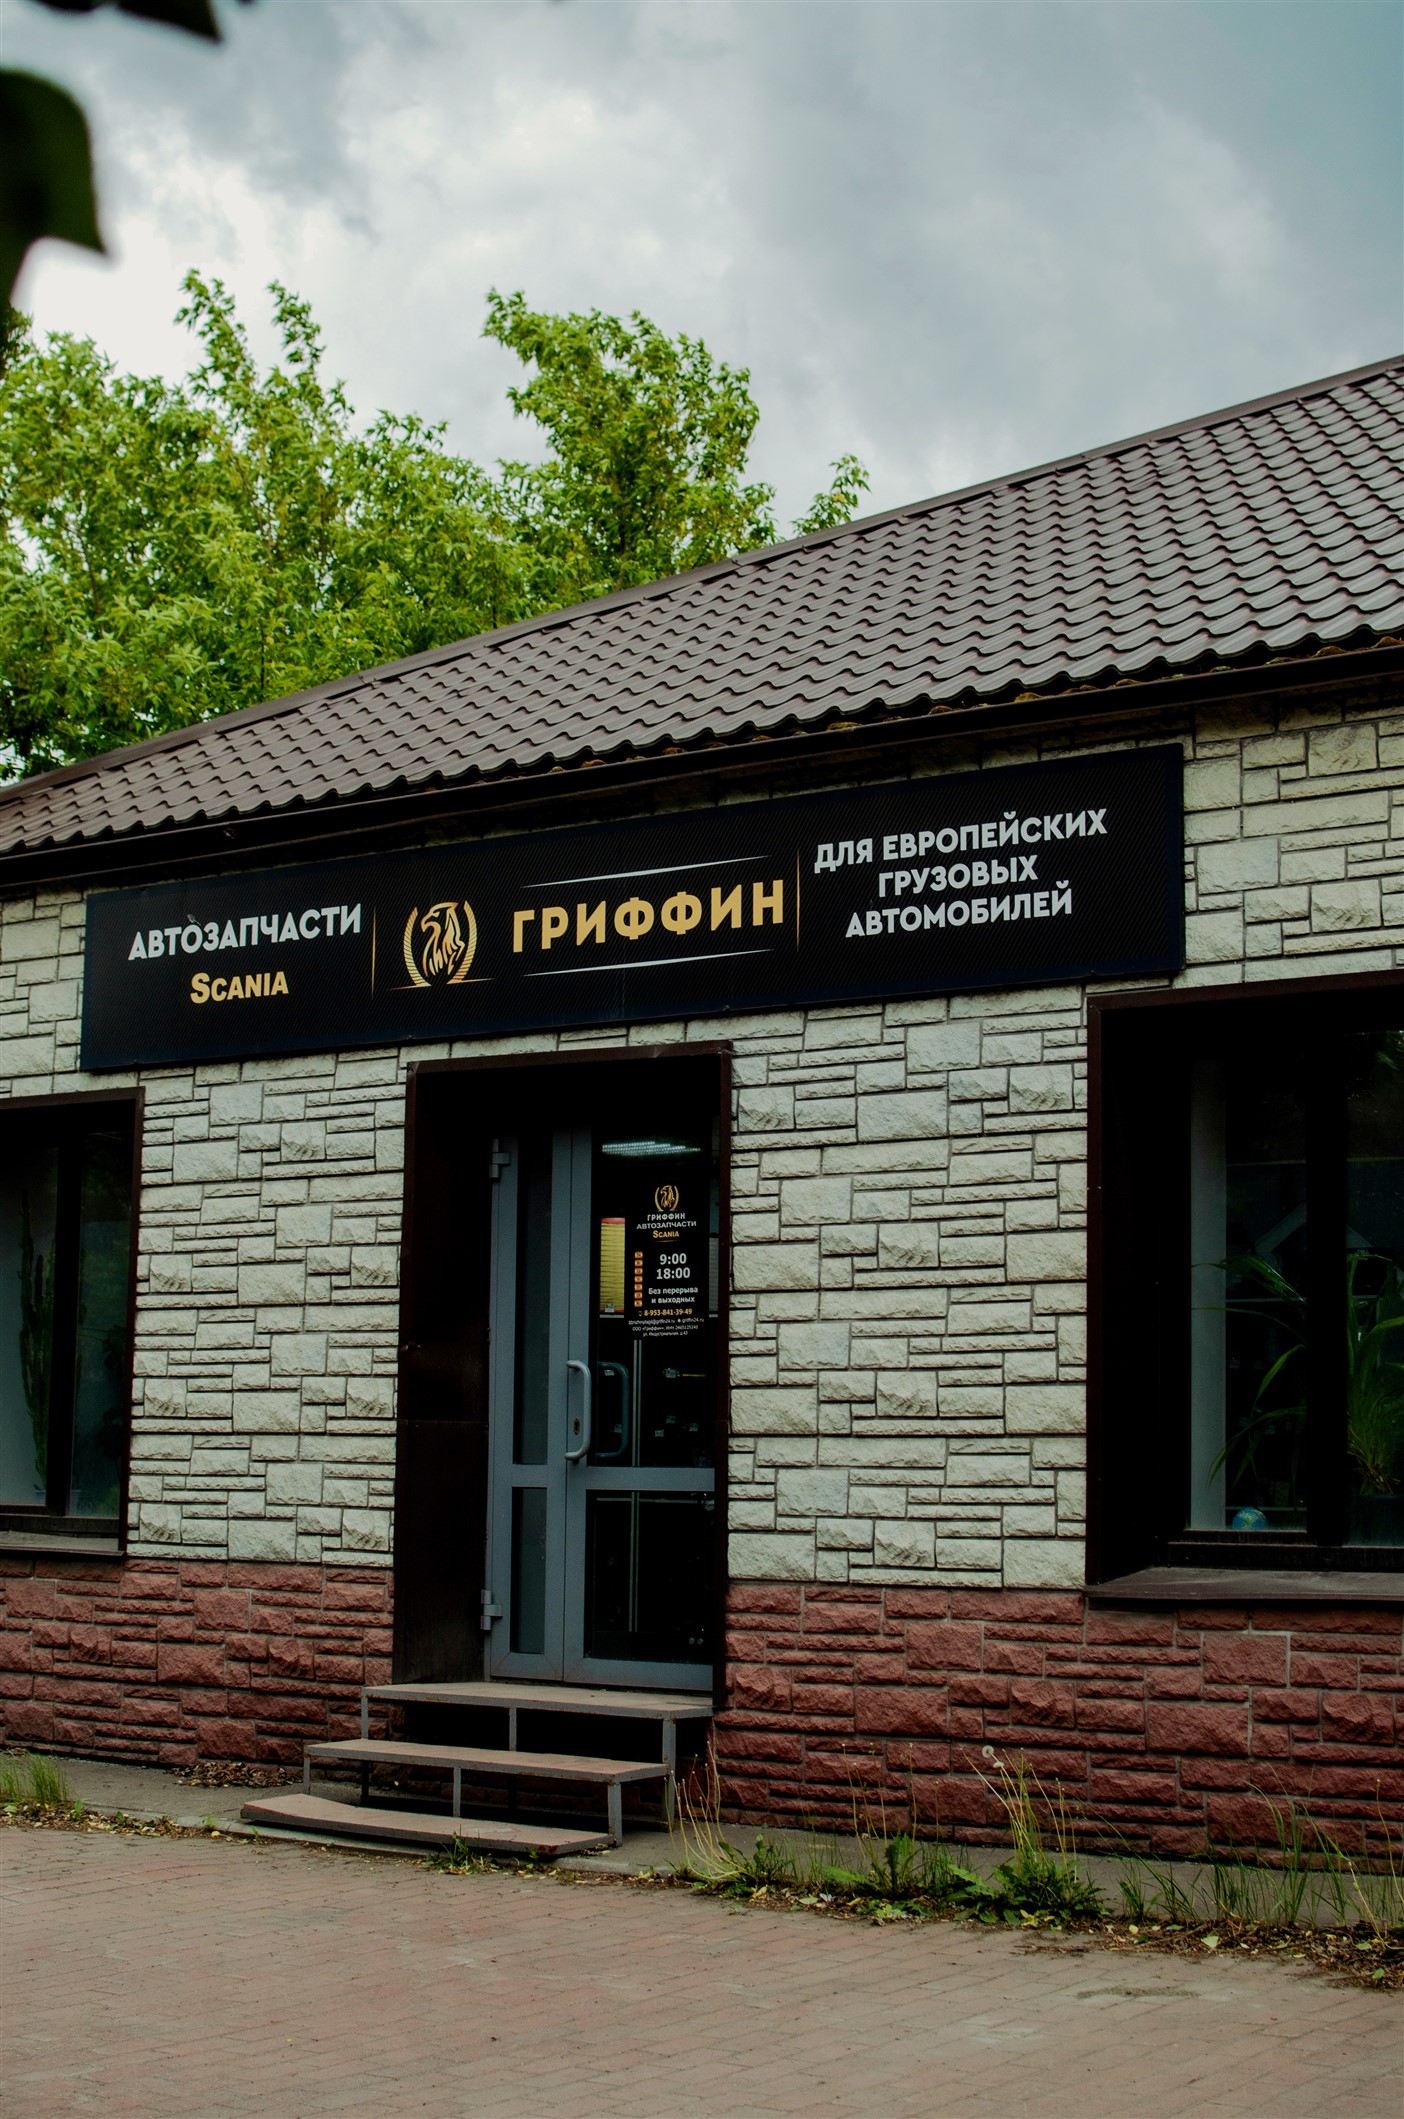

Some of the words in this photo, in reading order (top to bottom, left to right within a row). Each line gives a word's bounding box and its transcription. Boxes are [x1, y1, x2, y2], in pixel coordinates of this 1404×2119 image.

[814, 840, 873, 874] ДЛЯ
[883, 808, 1108, 861] ЕВРОПЕЙСКИХ
[878, 854, 1039, 898] ГРУЗОВЫХ
[512, 879, 784, 953] ГРИФФИН
[845, 880, 1072, 938] АВТОМОБИЛЕЙ
[127, 903, 361, 961] АВТОЗАПЧАСТИ
[647, 1212, 686, 1222] ГРИФФИН
[636, 1220, 697, 1230] АВТОЗАПЧАСТИ
[659, 1252, 687, 1266] 9:00
[656, 1266, 691, 1280] 18:00
[648, 1287, 661, 1295] Без
[662, 1286, 699, 1296] перерыва
[657, 1296, 695, 1305] выходных
[643, 1308, 693, 1317] 8-953-841-39-49
